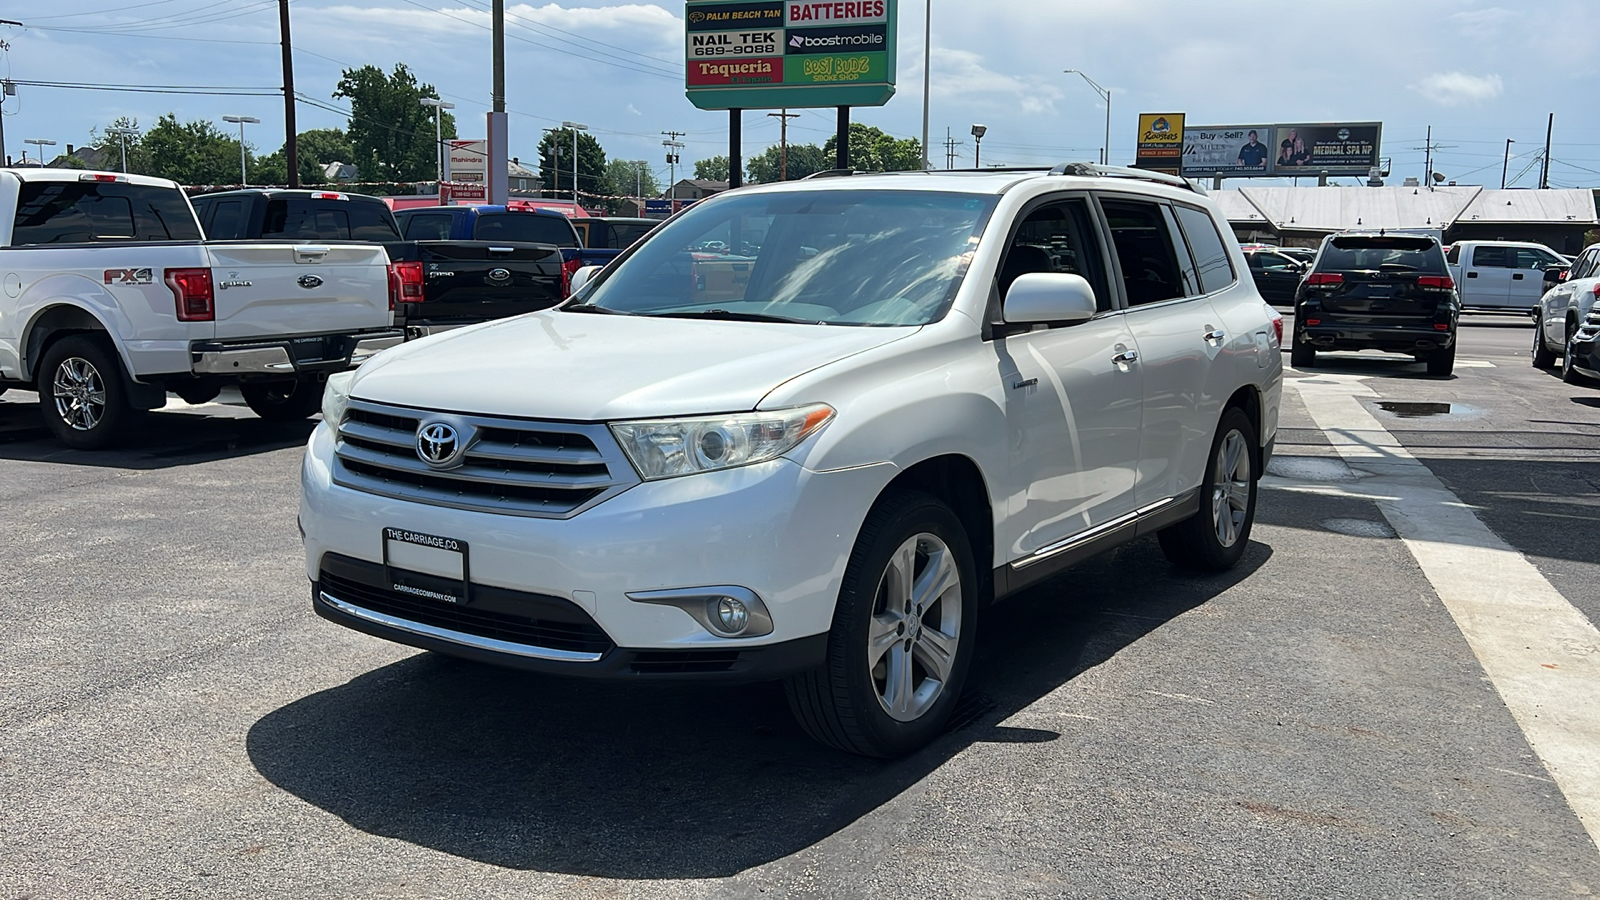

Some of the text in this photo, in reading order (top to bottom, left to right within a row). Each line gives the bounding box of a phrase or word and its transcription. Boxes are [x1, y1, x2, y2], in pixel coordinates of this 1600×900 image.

[706, 9, 781, 20] PALM BEACH TAN
[790, 0, 884, 21] BATTERIES
[693, 32, 776, 46] NAIL TEK
[695, 45, 775, 56] 689-9088
[835, 56, 869, 74] BUDZ
[813, 74, 837, 82] SMOKE
[1143, 131, 1178, 141] Roosters
[1200, 132, 1216, 140] Buy
[1224, 131, 1243, 139] Sell?
[1313, 145, 1373, 155] MEDICAL SPA NP
[104, 268, 153, 285] FX4
[386, 528, 460, 550] THE CARRIAGE CO.
[393, 583, 457, 603] CARRIAGECOMPANY.COM
